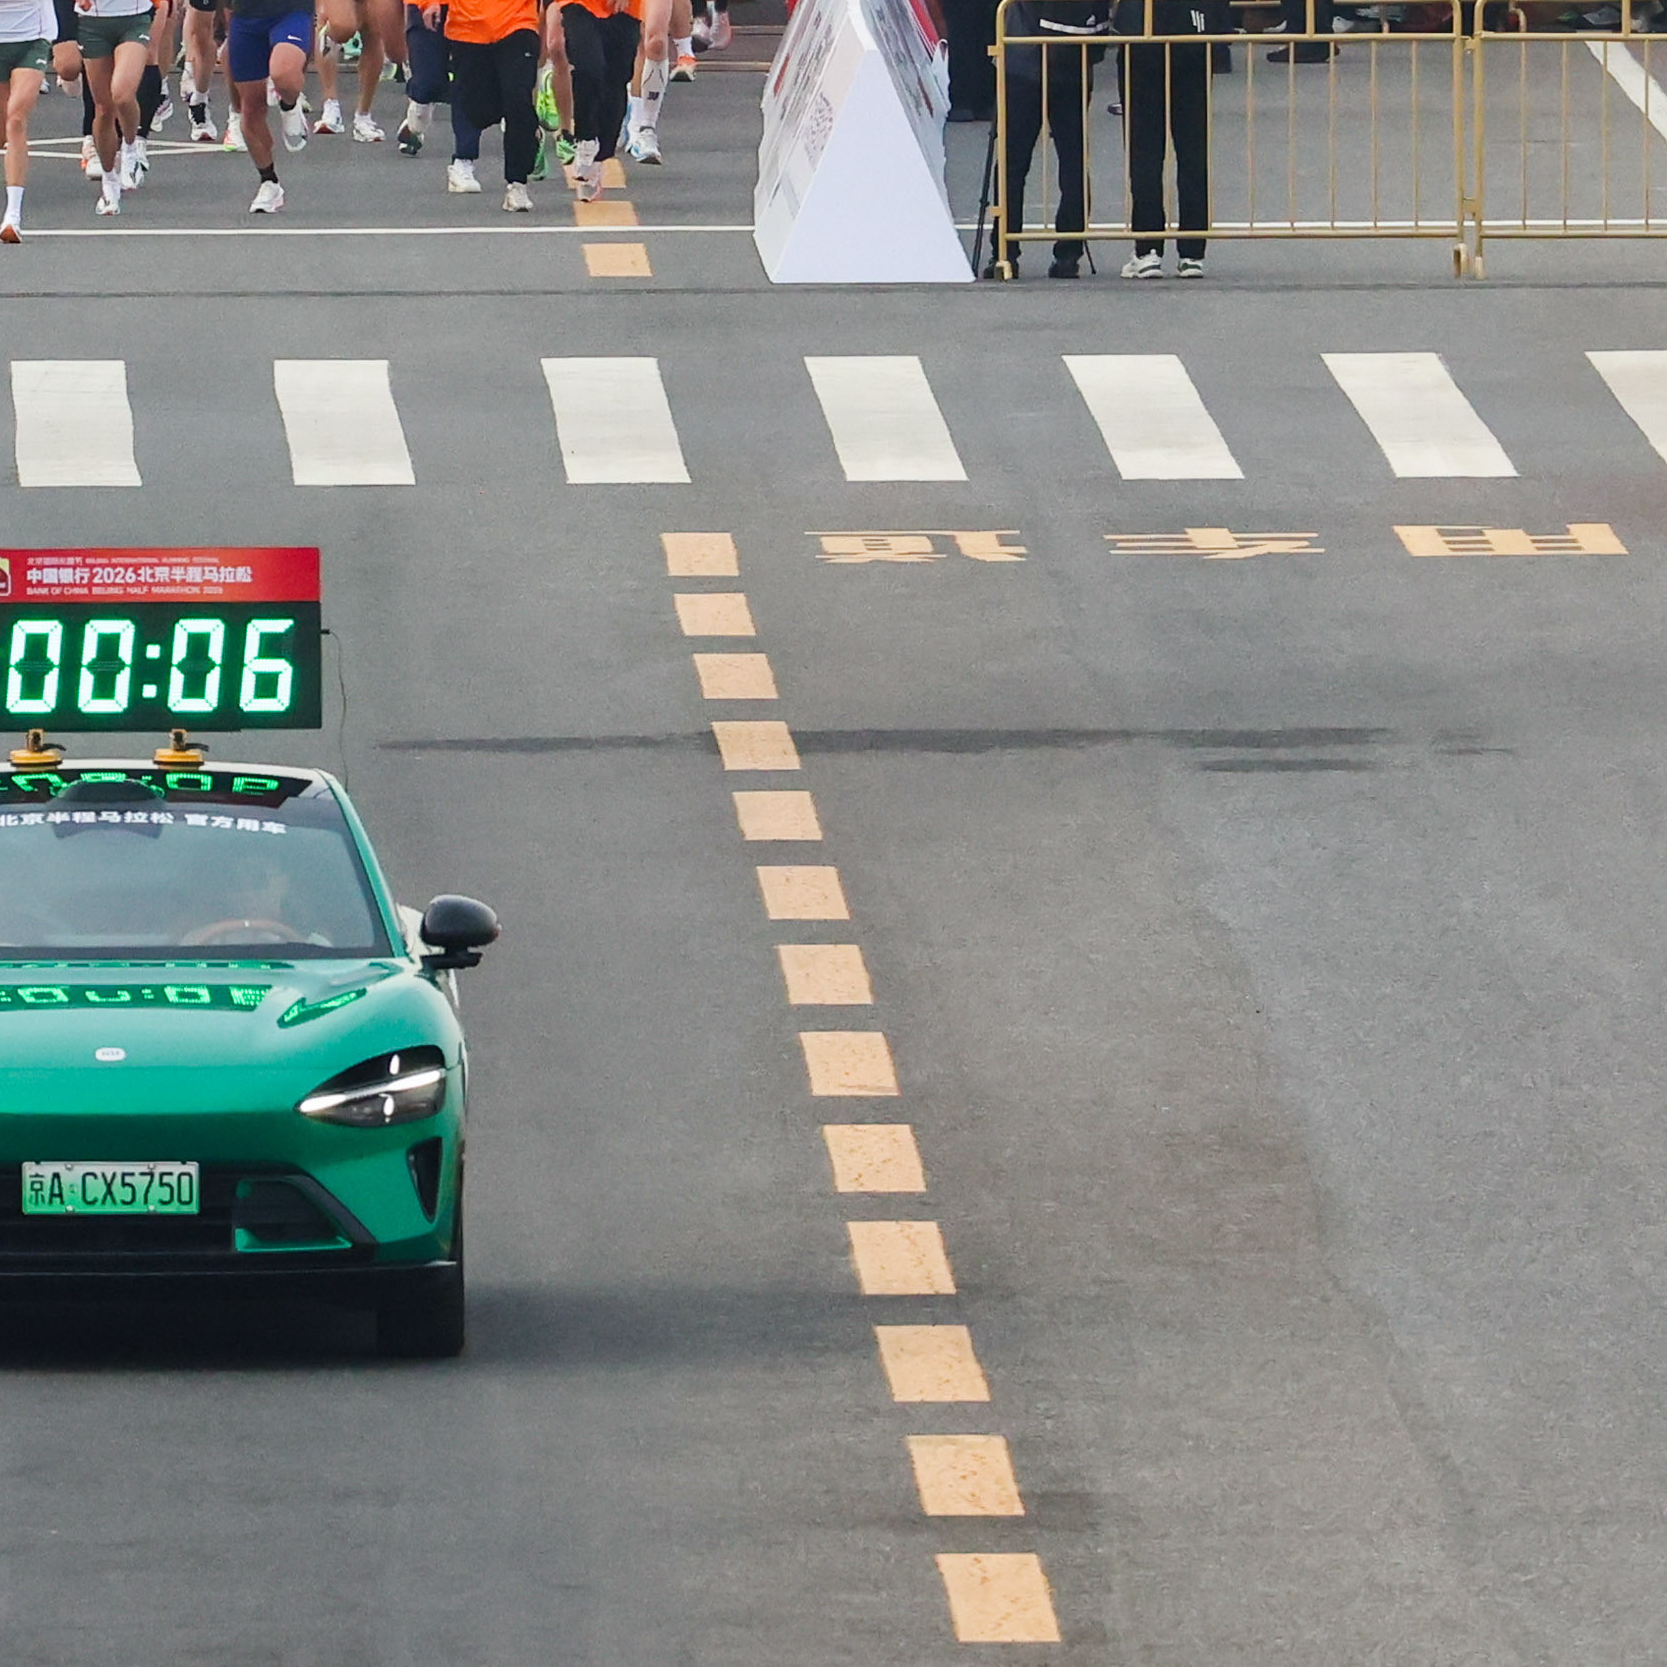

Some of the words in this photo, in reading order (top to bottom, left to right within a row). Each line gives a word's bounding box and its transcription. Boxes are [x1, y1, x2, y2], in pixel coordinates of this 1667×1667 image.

[185, 812, 289, 836] 官方用车
[81, 1171, 195, 1206] CX5750
